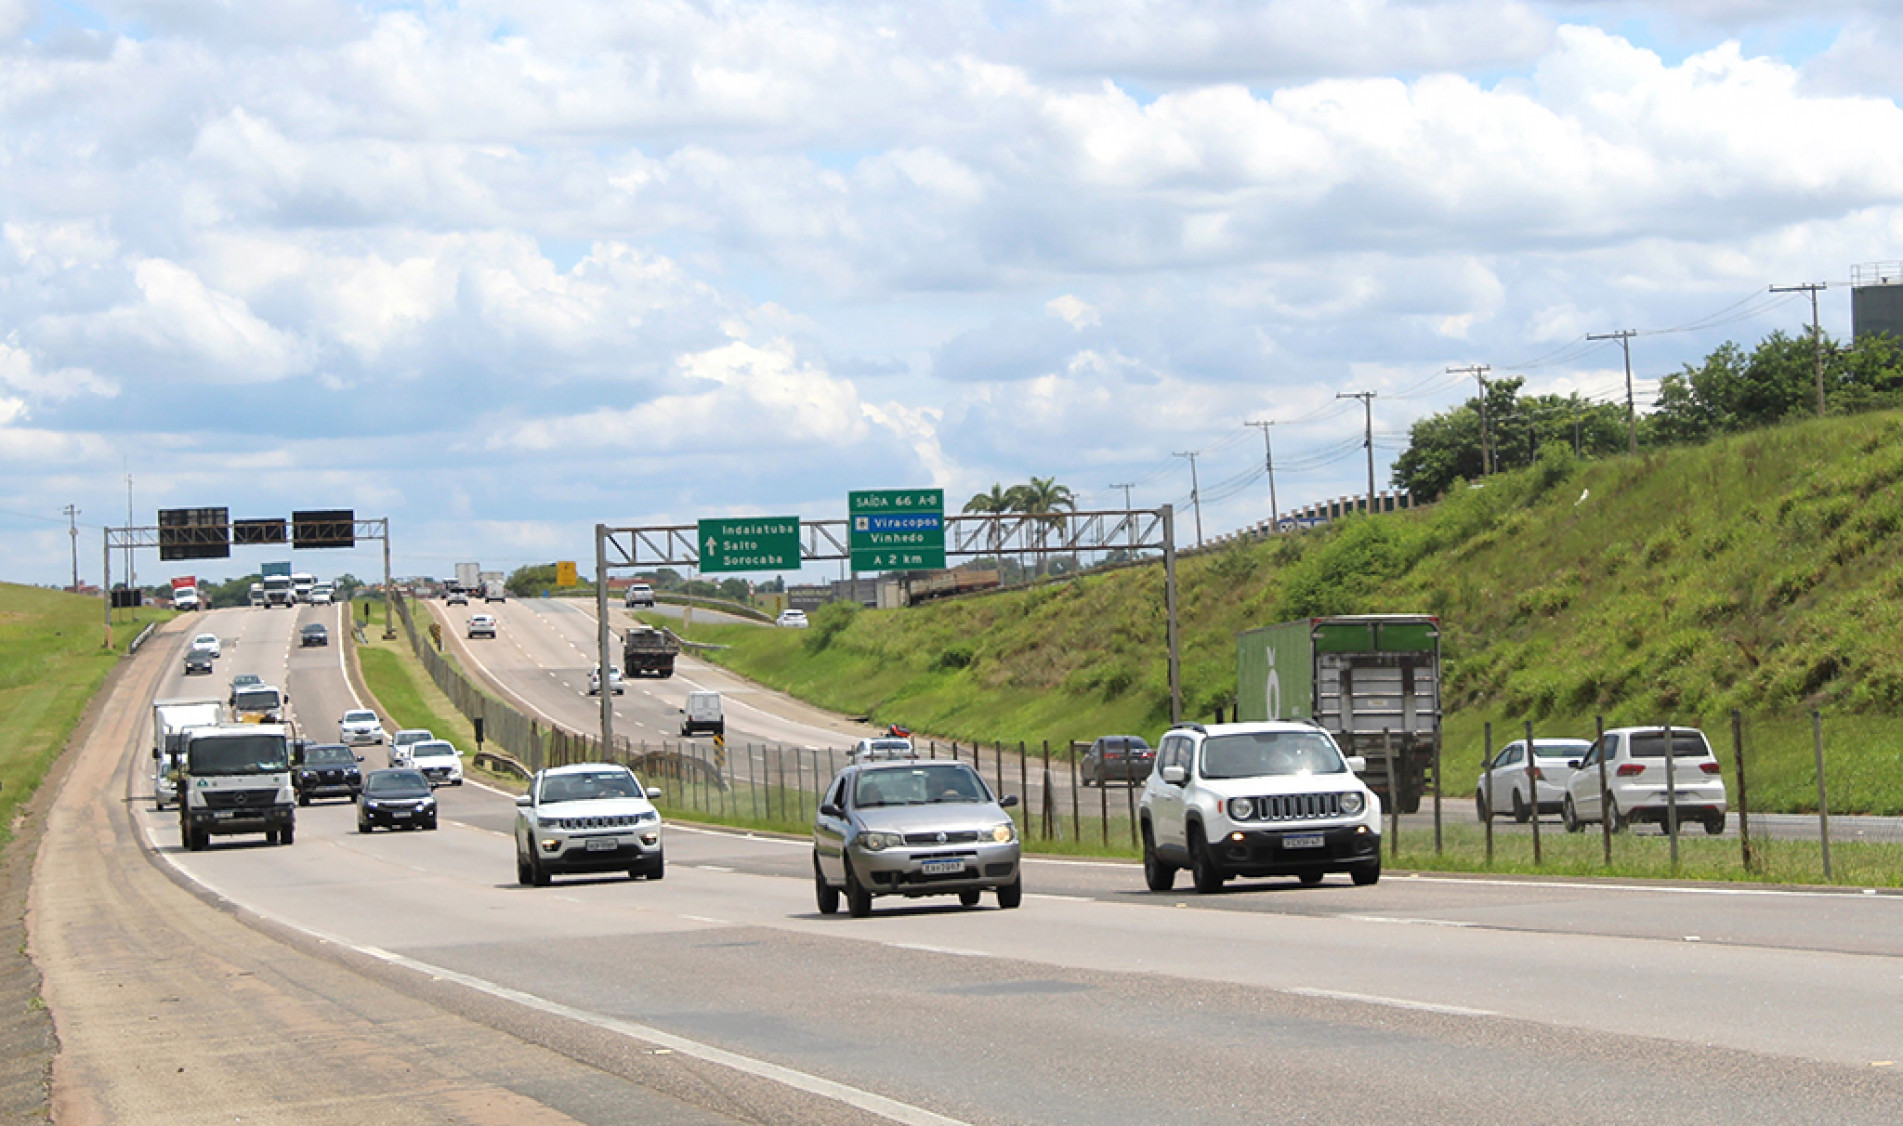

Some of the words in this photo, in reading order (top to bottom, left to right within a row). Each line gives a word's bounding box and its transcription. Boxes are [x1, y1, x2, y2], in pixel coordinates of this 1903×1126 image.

[895, 495, 912, 506] 66
[874, 517, 939, 528] Viracopos
[722, 524, 794, 535] Indaiatuba
[870, 533, 924, 543] Vinhedo
[723, 540, 758, 551] Salto
[723, 554, 783, 566] Sorocaba
[873, 555, 882, 565] A
[888, 554, 897, 565] 2
[903, 554, 923, 564] km
